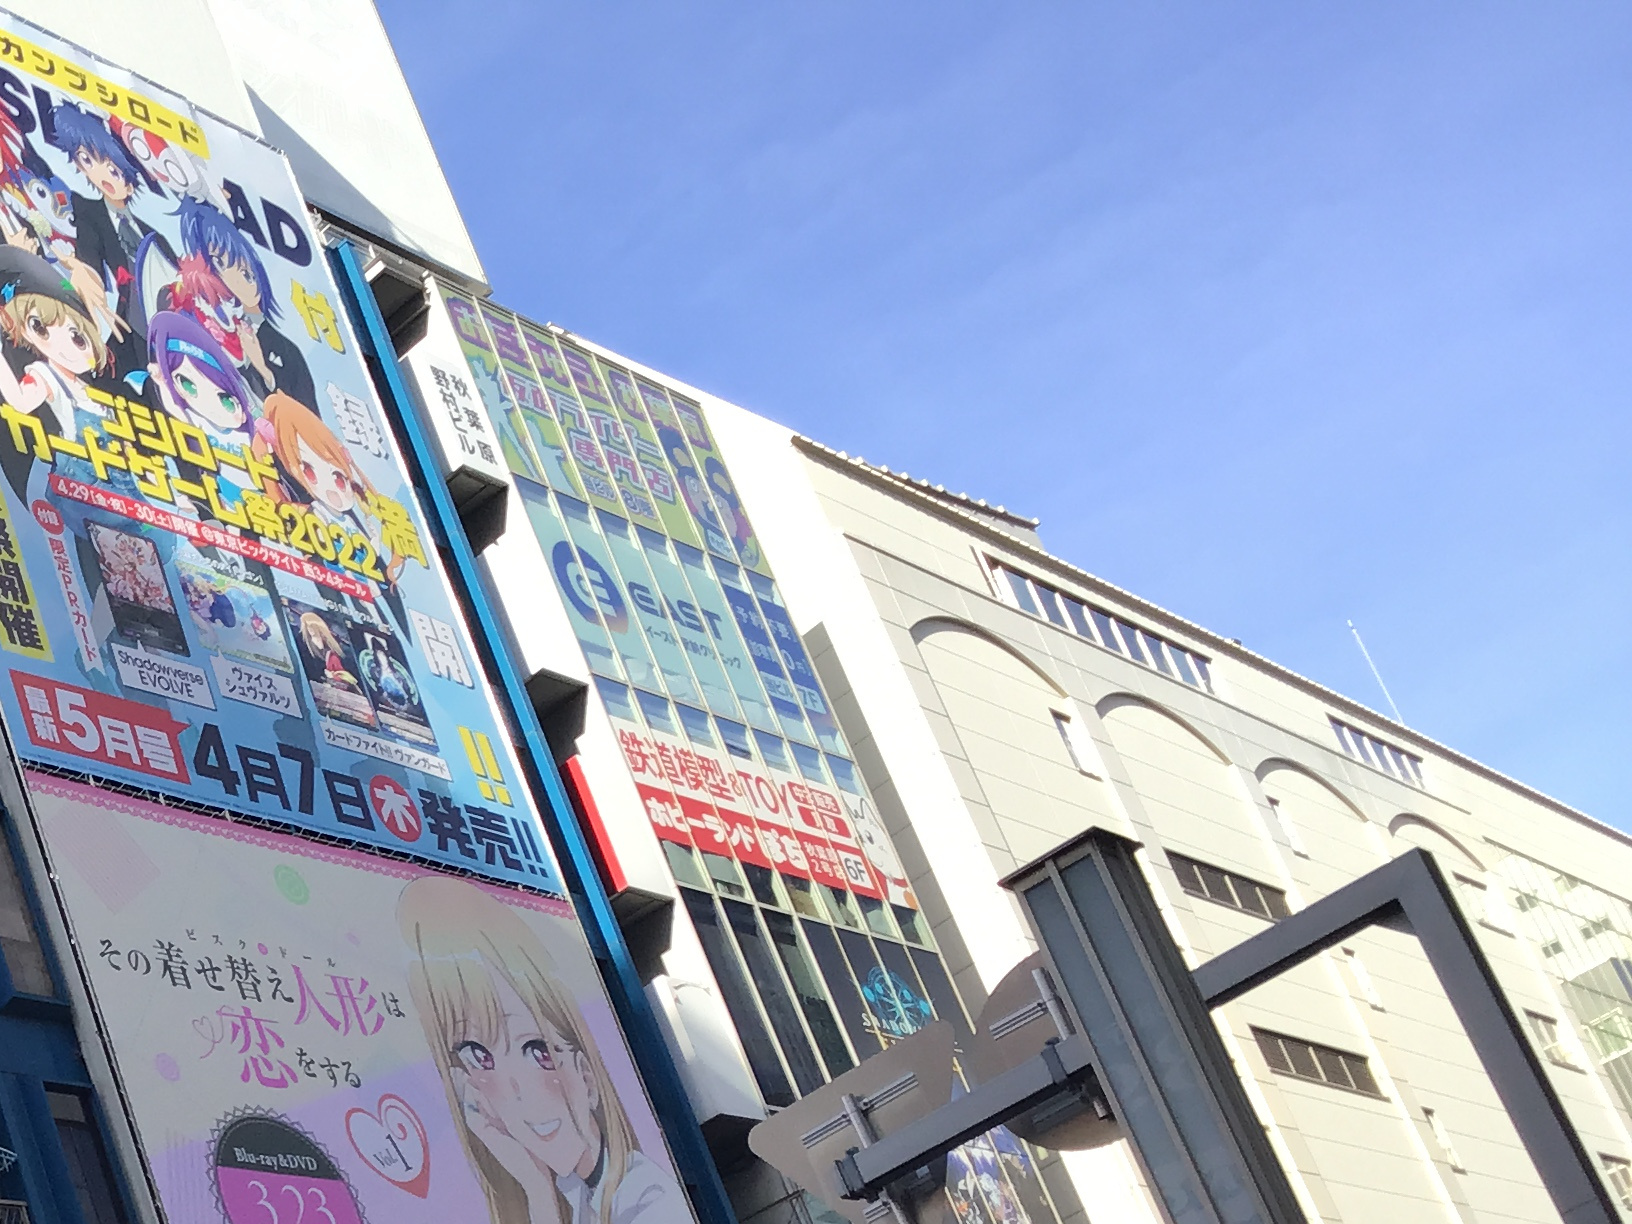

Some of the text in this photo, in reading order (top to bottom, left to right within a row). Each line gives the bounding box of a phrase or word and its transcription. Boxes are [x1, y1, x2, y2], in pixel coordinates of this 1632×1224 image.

[430, 365, 475, 455] 野村ビル
[450, 374, 498, 466] 秋葉原
[628, 581, 724, 641] EAST
[118, 651, 205, 686] Shadowverse
[139, 671, 197, 700] EVOLVE
[231, 665, 276, 690] ヴァイス
[225, 677, 292, 709] シュヴァルツ
[23, 685, 181, 773] 最新 5月号
[394, 747, 448, 782] ヴァンガード
[844, 857, 867, 884] 6F
[99, 937, 406, 1037] その着せ替え人形は
[216, 1004, 362, 1089] 恋をする
[233, 1146, 318, 1172] Blu-ray&DVD
